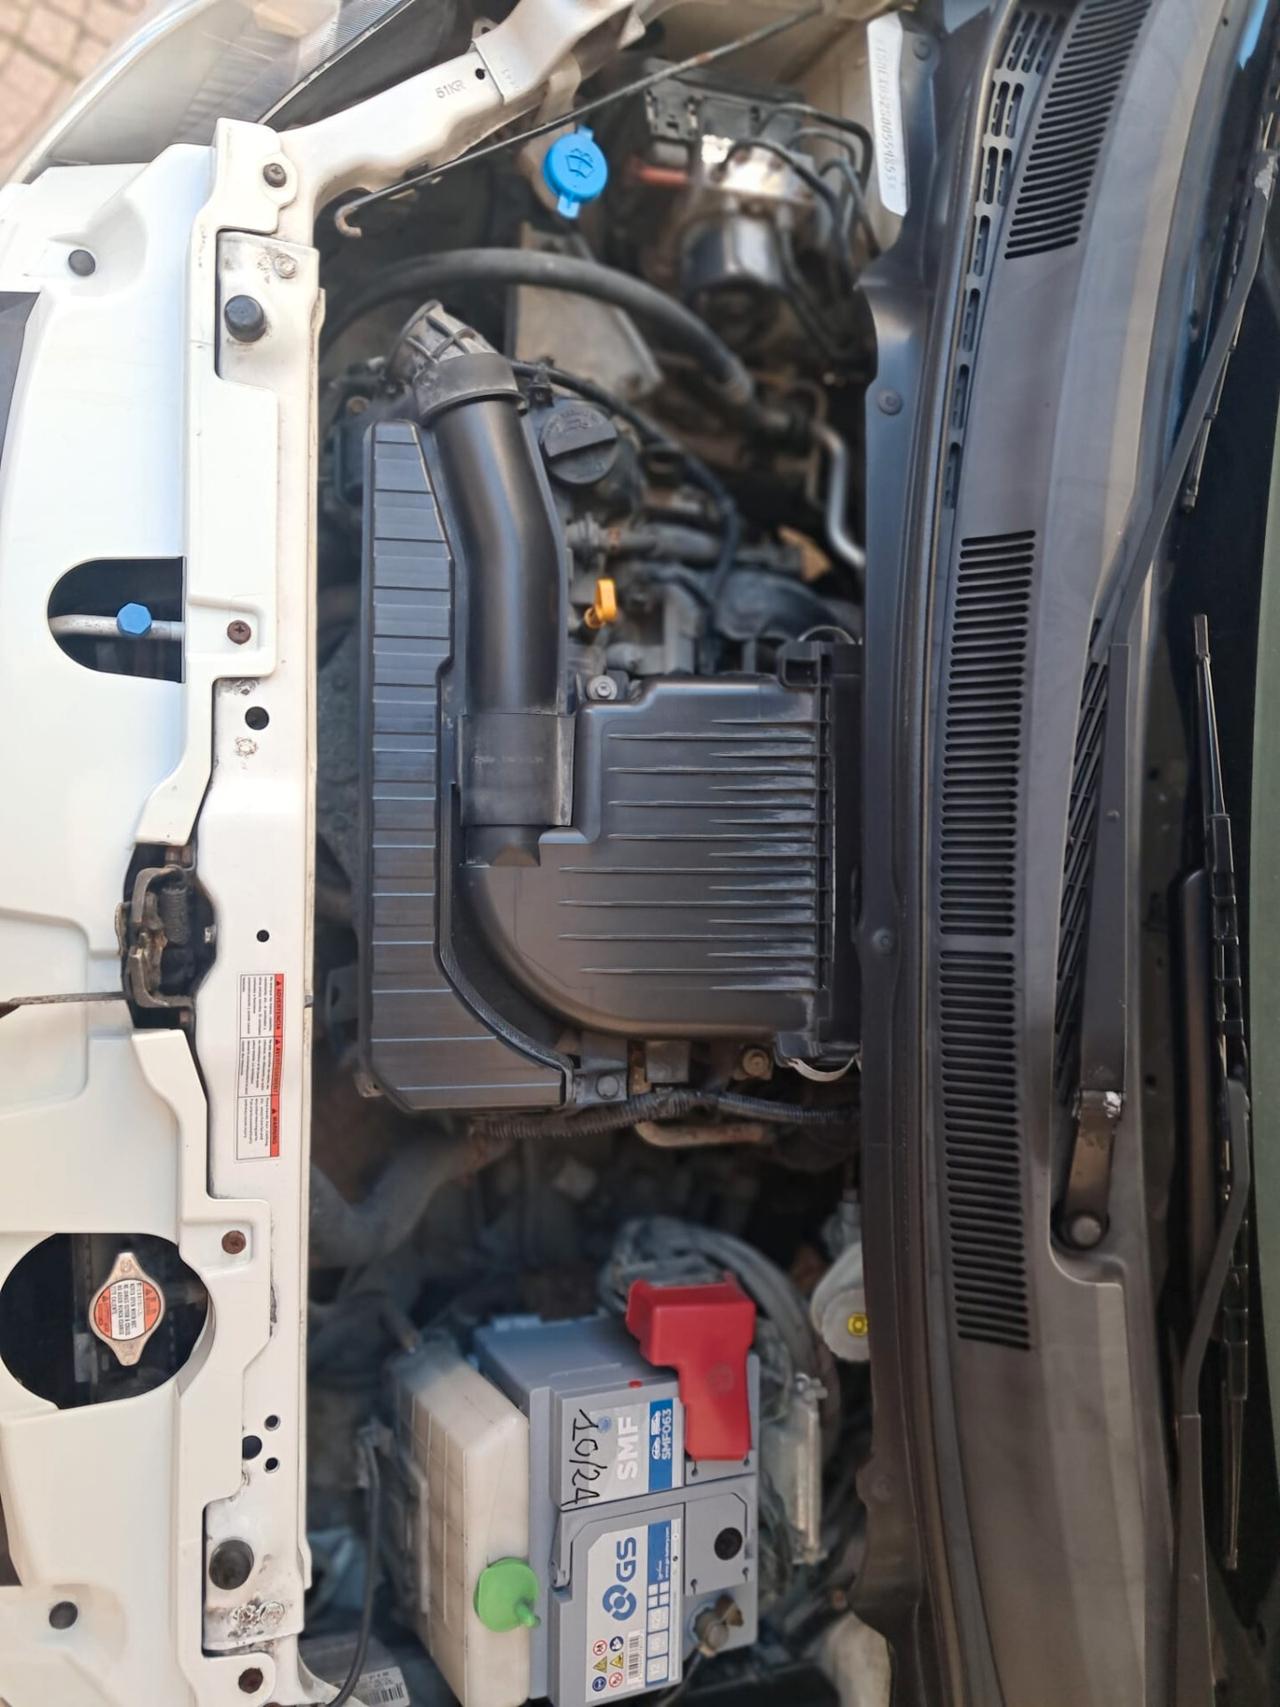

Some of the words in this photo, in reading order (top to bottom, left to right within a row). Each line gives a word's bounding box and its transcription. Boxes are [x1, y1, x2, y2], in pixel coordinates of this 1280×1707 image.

[561, 1408, 607, 1507] 10/24
[616, 1416, 639, 1480] SMF
[661, 1408, 672, 1460] SMF063
[615, 1536, 637, 1582] GS
